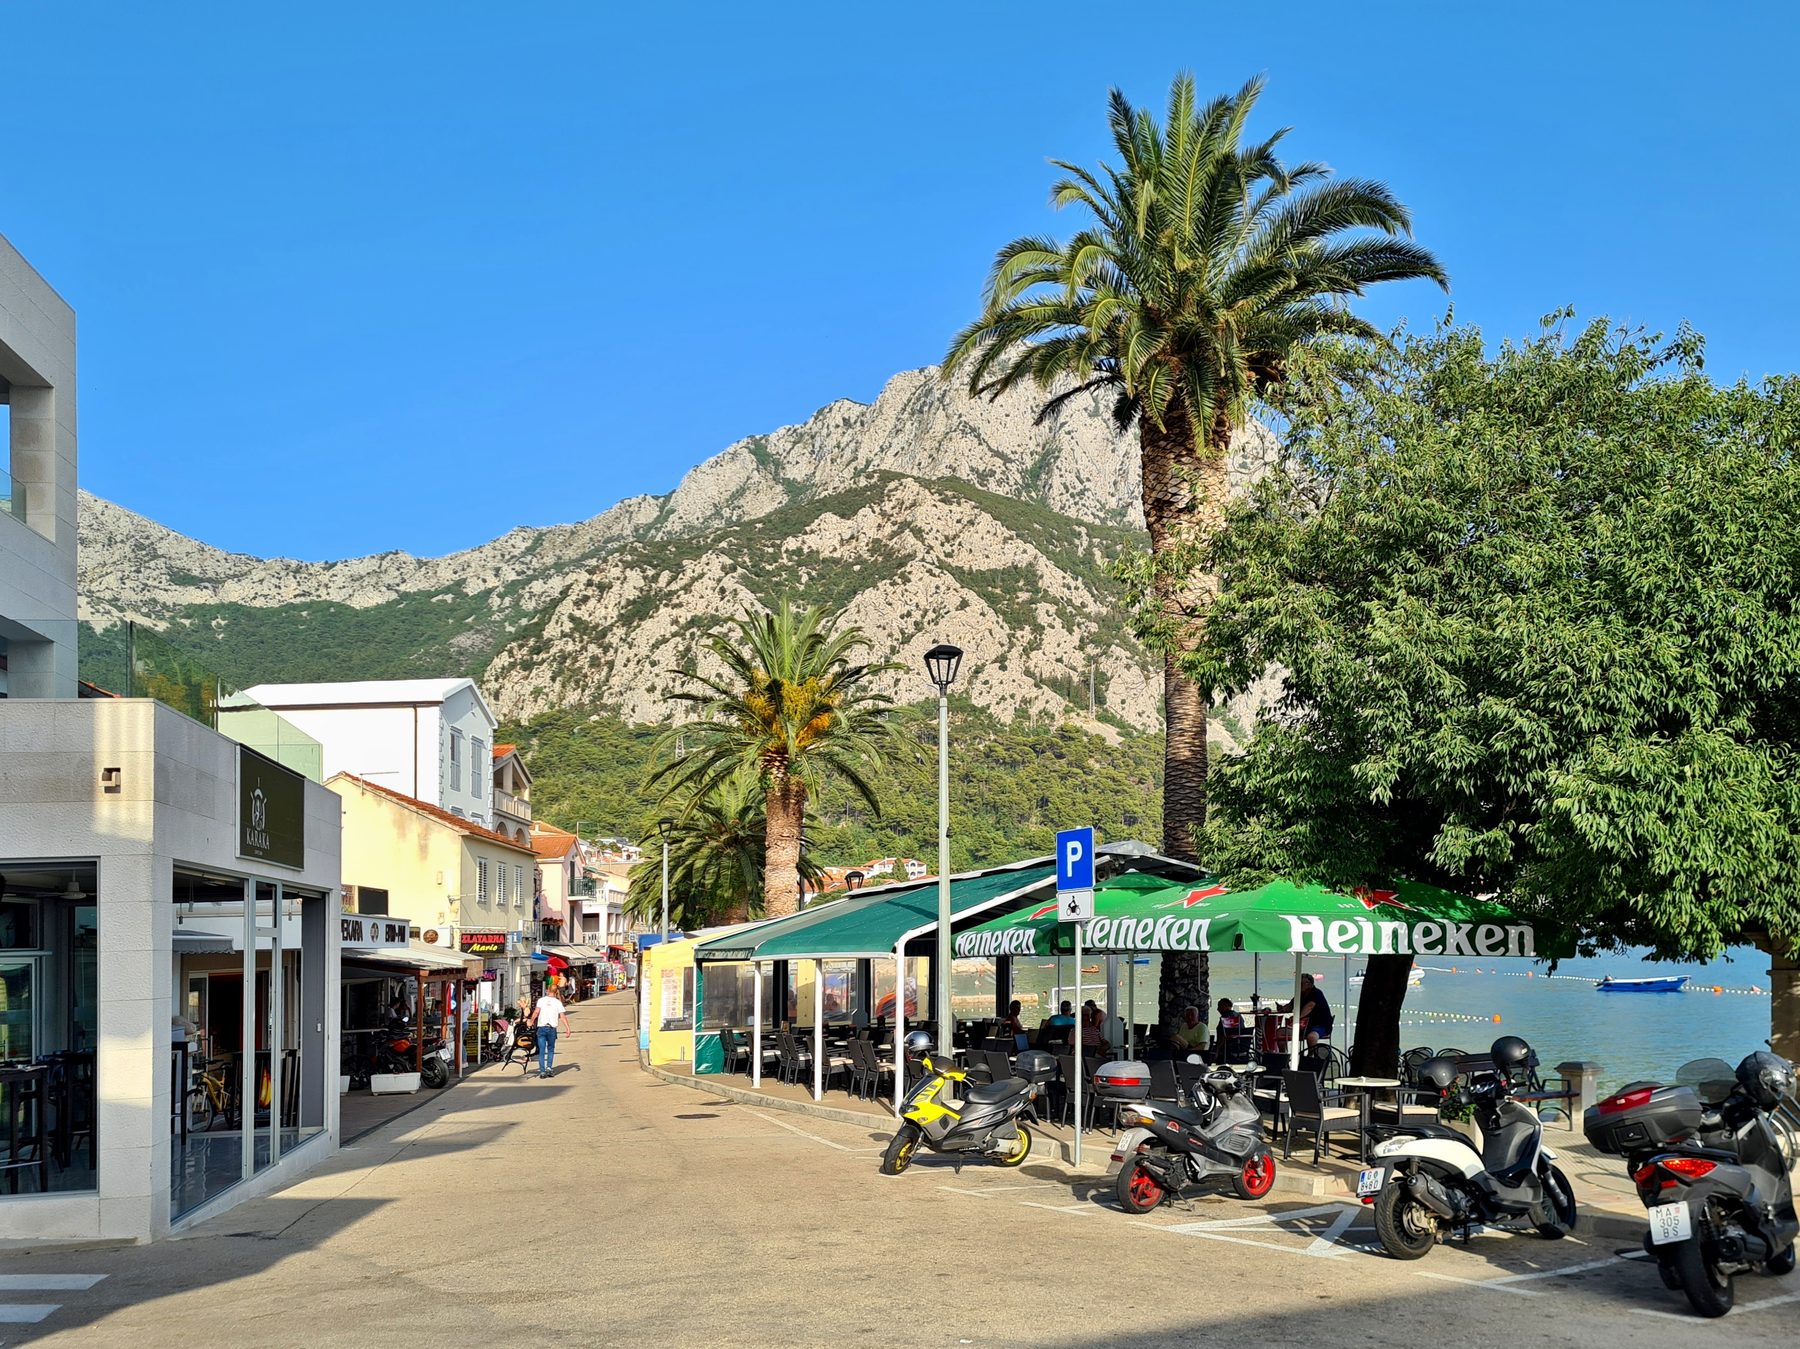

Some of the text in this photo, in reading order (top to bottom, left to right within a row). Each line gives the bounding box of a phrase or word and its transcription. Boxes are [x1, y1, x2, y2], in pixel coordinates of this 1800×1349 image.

[246, 827, 270, 850] KARAKA
[1066, 840, 1083, 878] P
[461, 934, 505, 944] ZLATARNA
[955, 927, 1037, 957] Heineken
[1290, 915, 1537, 956] Heineken
[467, 943, 498, 954] Mario
[1656, 1208, 1672, 1218] MA
[1660, 1216, 1680, 1228] 305
